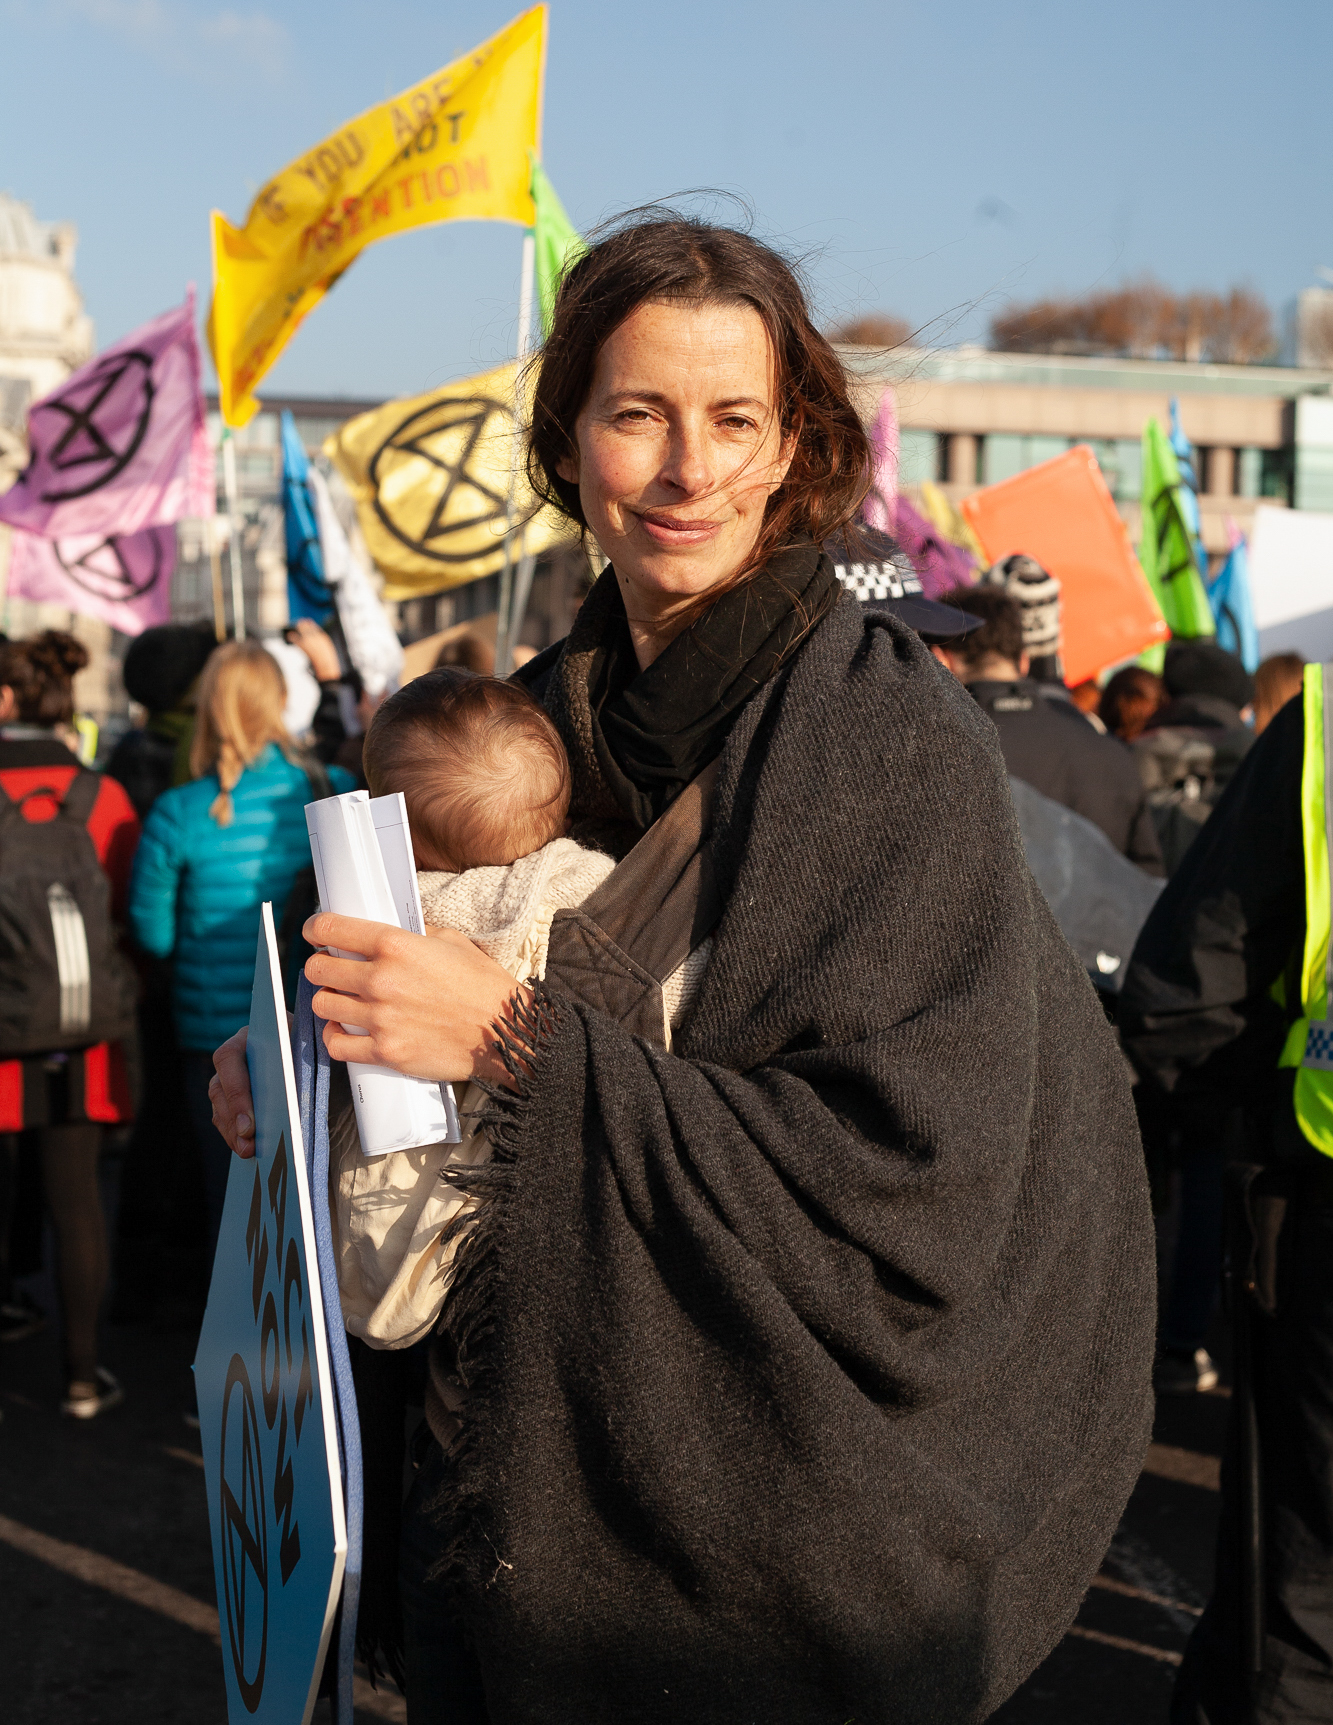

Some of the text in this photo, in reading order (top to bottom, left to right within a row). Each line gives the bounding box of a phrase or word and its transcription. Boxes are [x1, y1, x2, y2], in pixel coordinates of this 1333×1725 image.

[295, 130, 366, 194] YOU
[389, 77, 457, 147] ARE
[245, 1161, 301, 1587] NOW
[268, 1130, 313, 1449] ACT
